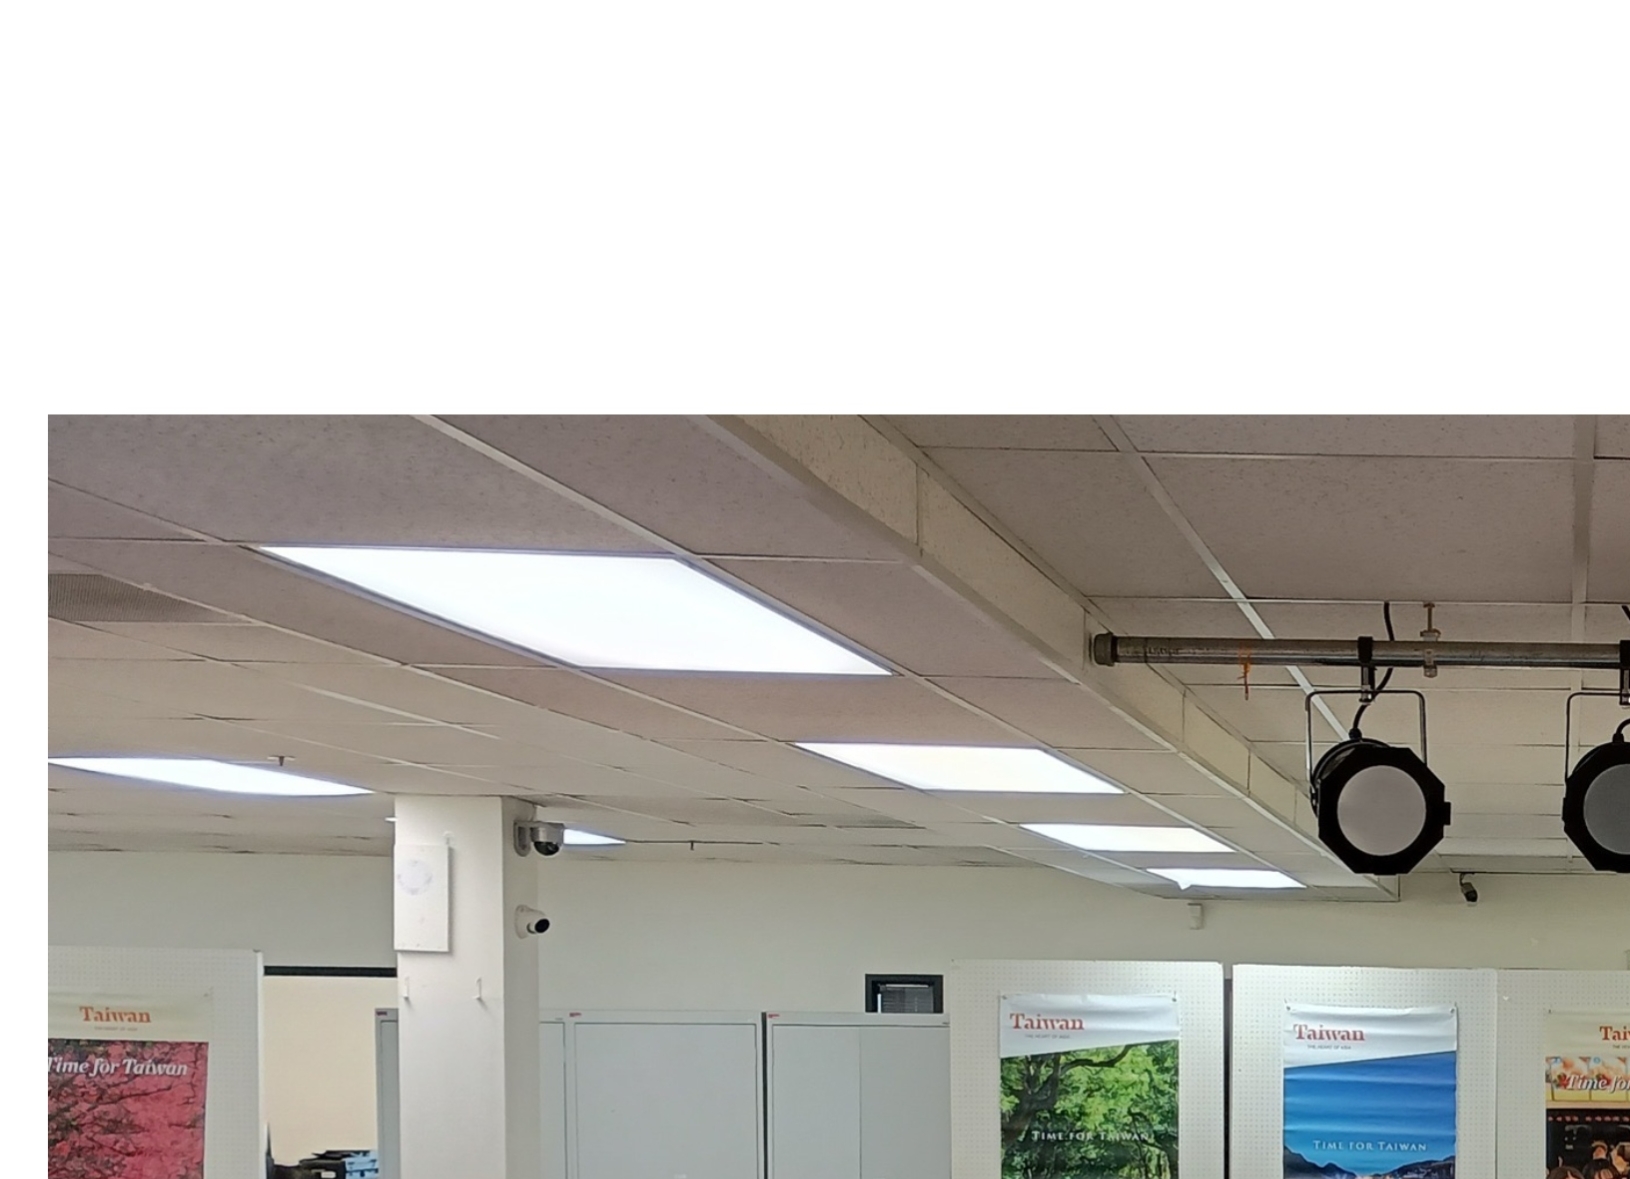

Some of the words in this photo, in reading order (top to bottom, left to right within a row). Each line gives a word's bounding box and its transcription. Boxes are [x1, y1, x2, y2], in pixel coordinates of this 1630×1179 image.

[79, 1006, 151, 1024] Taiwan
[1009, 1013, 1085, 1031] Taiwan
[1293, 1024, 1366, 1041] Taiwan
[89, 1057, 120, 1076] for
[123, 1058, 188, 1076] Taiwan
[1565, 1075, 1607, 1090] Time
[1031, 1131, 1064, 1141] TIME
[1069, 1131, 1094, 1141] FOR
[1100, 1131, 1148, 1141] TAIWAN
[1313, 1140, 1344, 1150] TIME
[1349, 1141, 1373, 1150] FOR
[1377, 1141, 1427, 1151] TAIWAN
